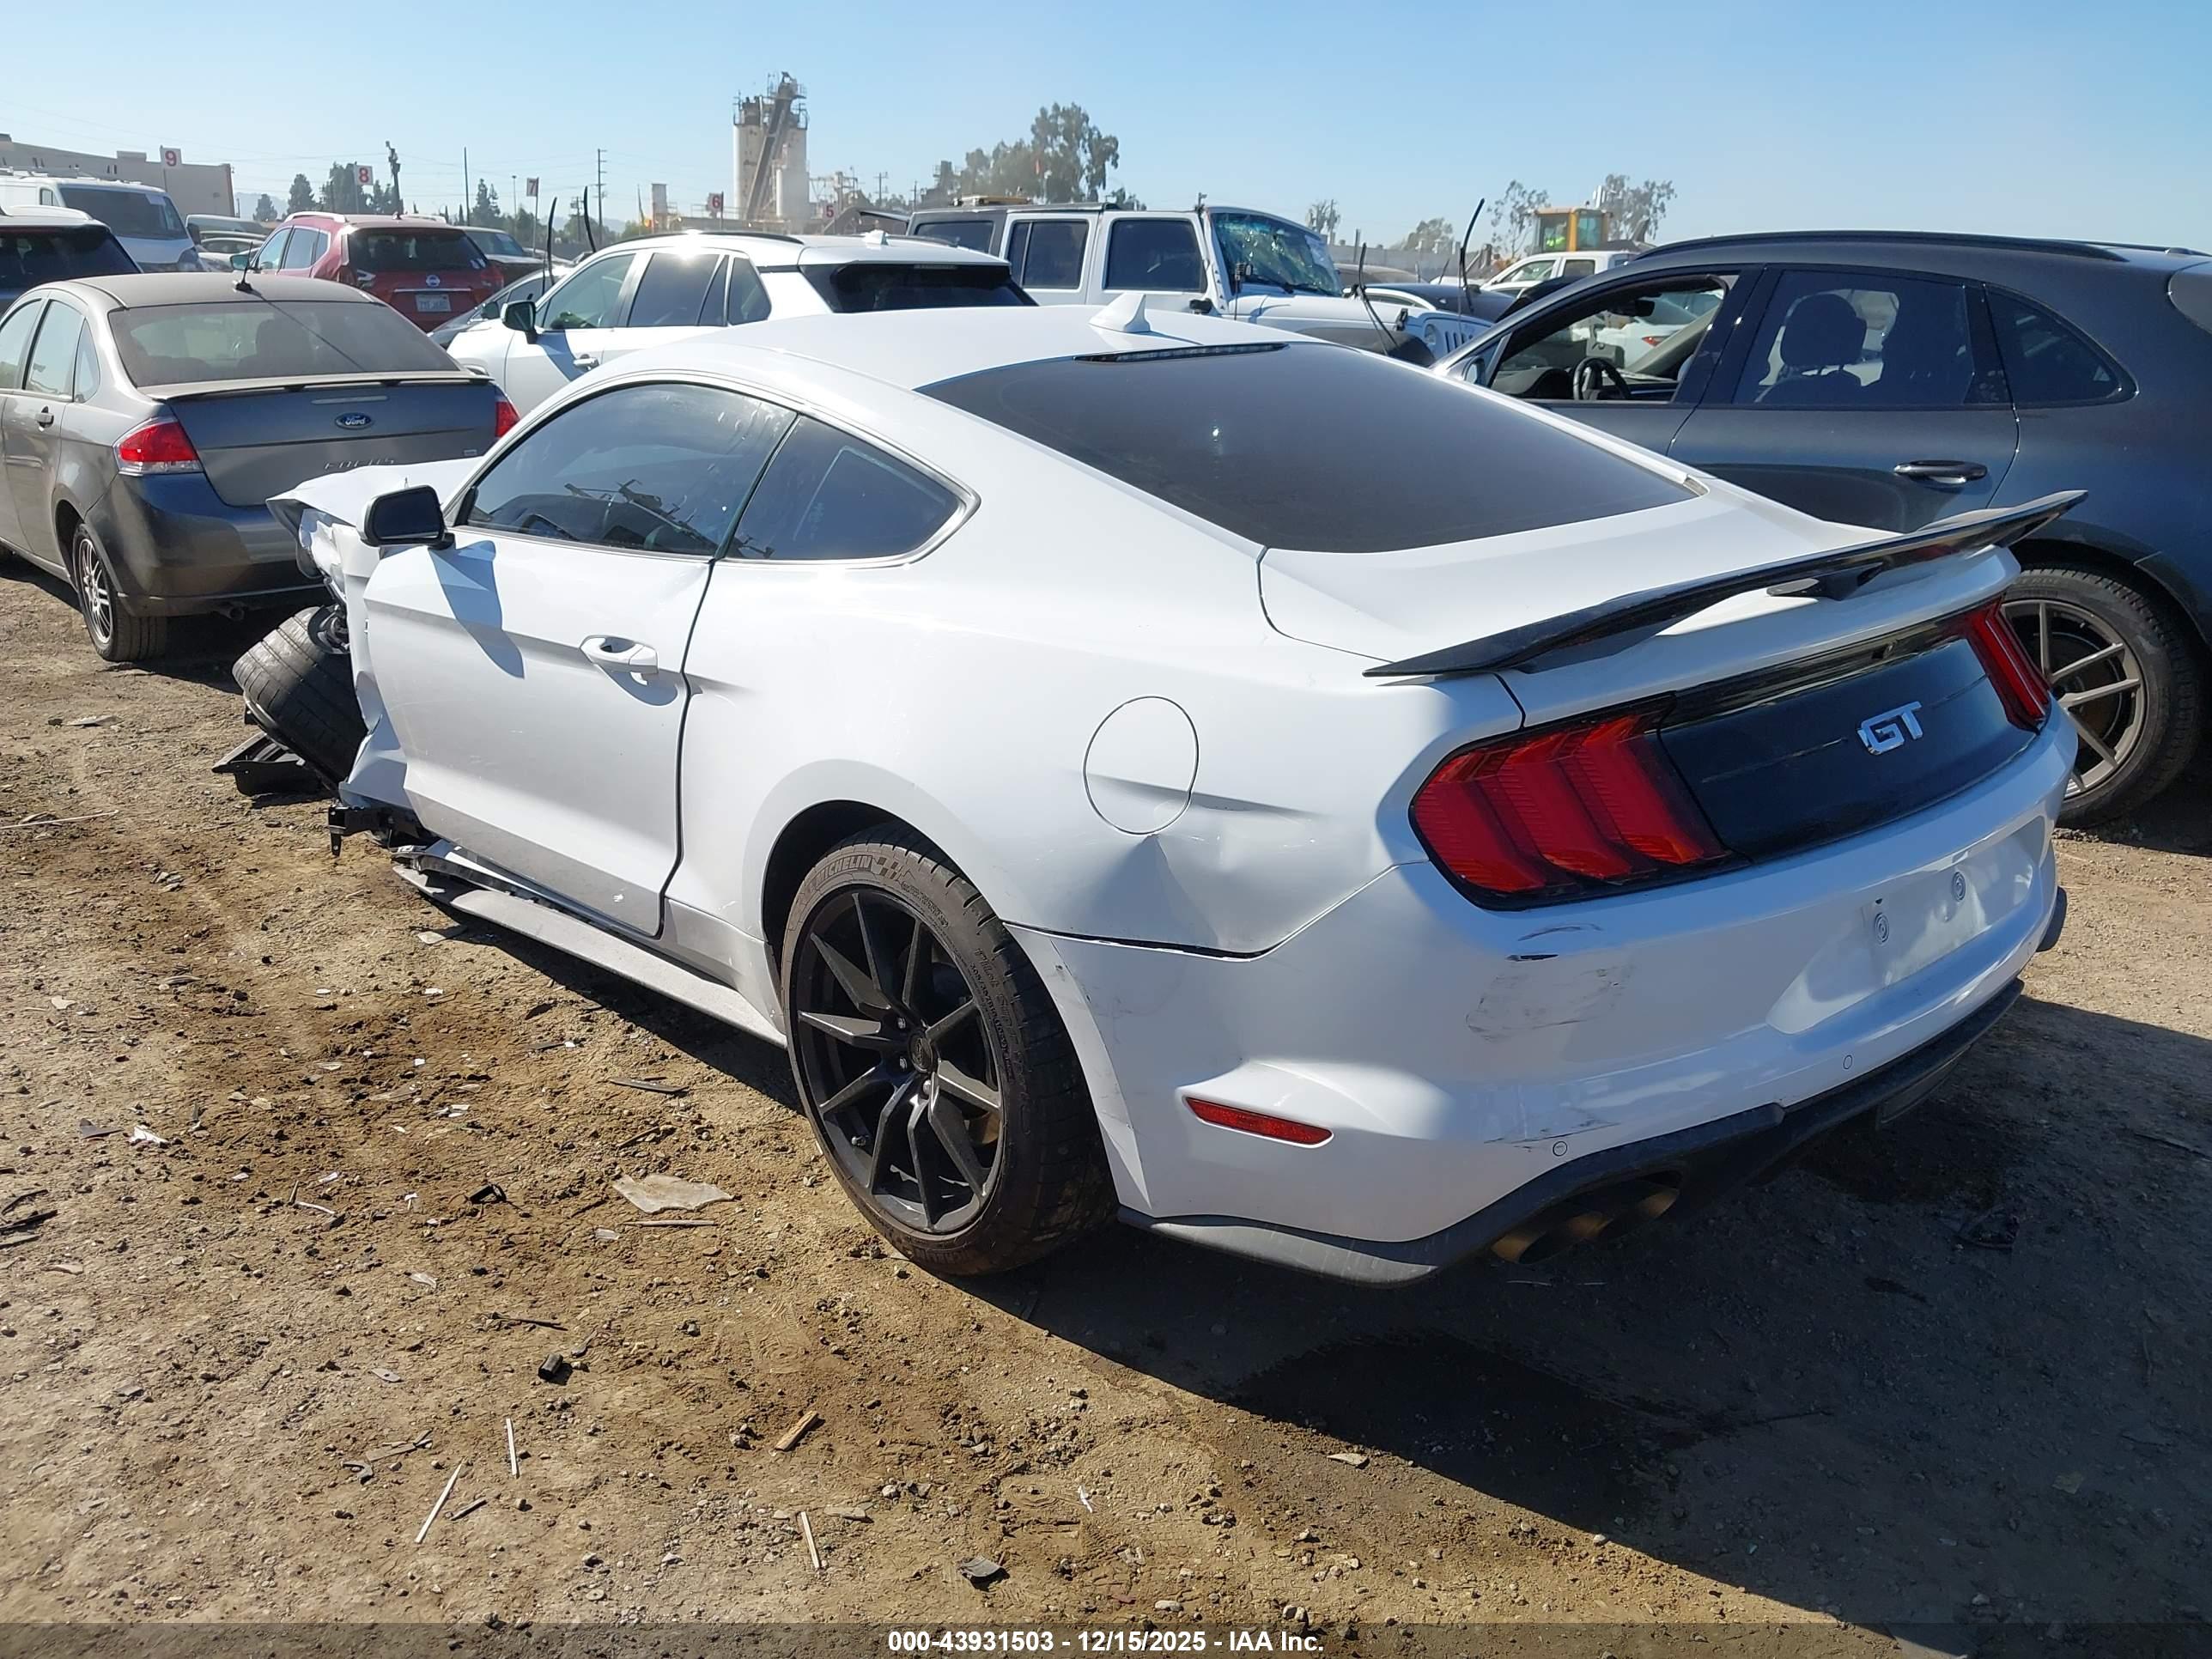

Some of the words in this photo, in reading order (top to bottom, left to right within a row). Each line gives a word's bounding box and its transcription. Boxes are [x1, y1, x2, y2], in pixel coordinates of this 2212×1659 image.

[164, 149, 177, 167] 9
[358, 167, 369, 184] 8
[528, 179, 537, 194] 7
[712, 194, 721, 210] 6
[826, 204, 835, 218] 5
[344, 416, 366, 426] Ford
[1856, 700, 1923, 756] GT
[815, 854, 872, 889] MICHELIN
